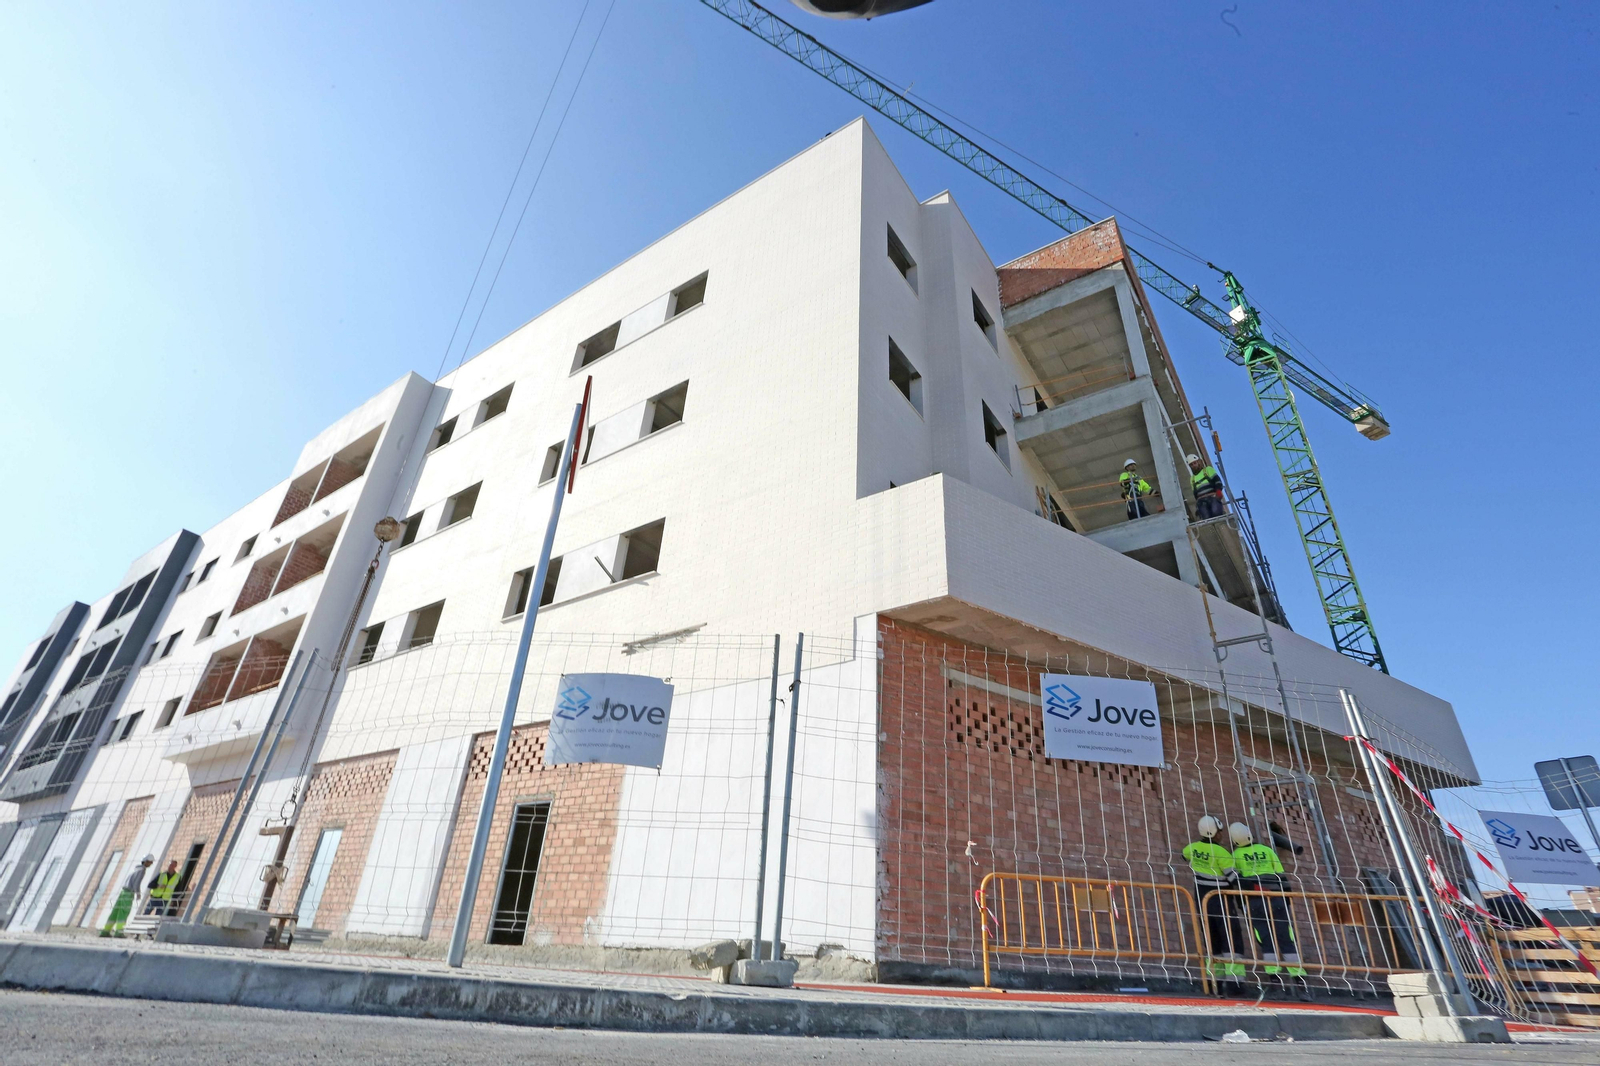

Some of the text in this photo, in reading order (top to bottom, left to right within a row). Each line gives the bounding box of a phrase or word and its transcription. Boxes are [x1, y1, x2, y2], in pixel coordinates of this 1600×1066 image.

[592, 697, 666, 725] Jove
[1087, 698, 1156, 728] Jove
[1526, 830, 1582, 854] Jove
